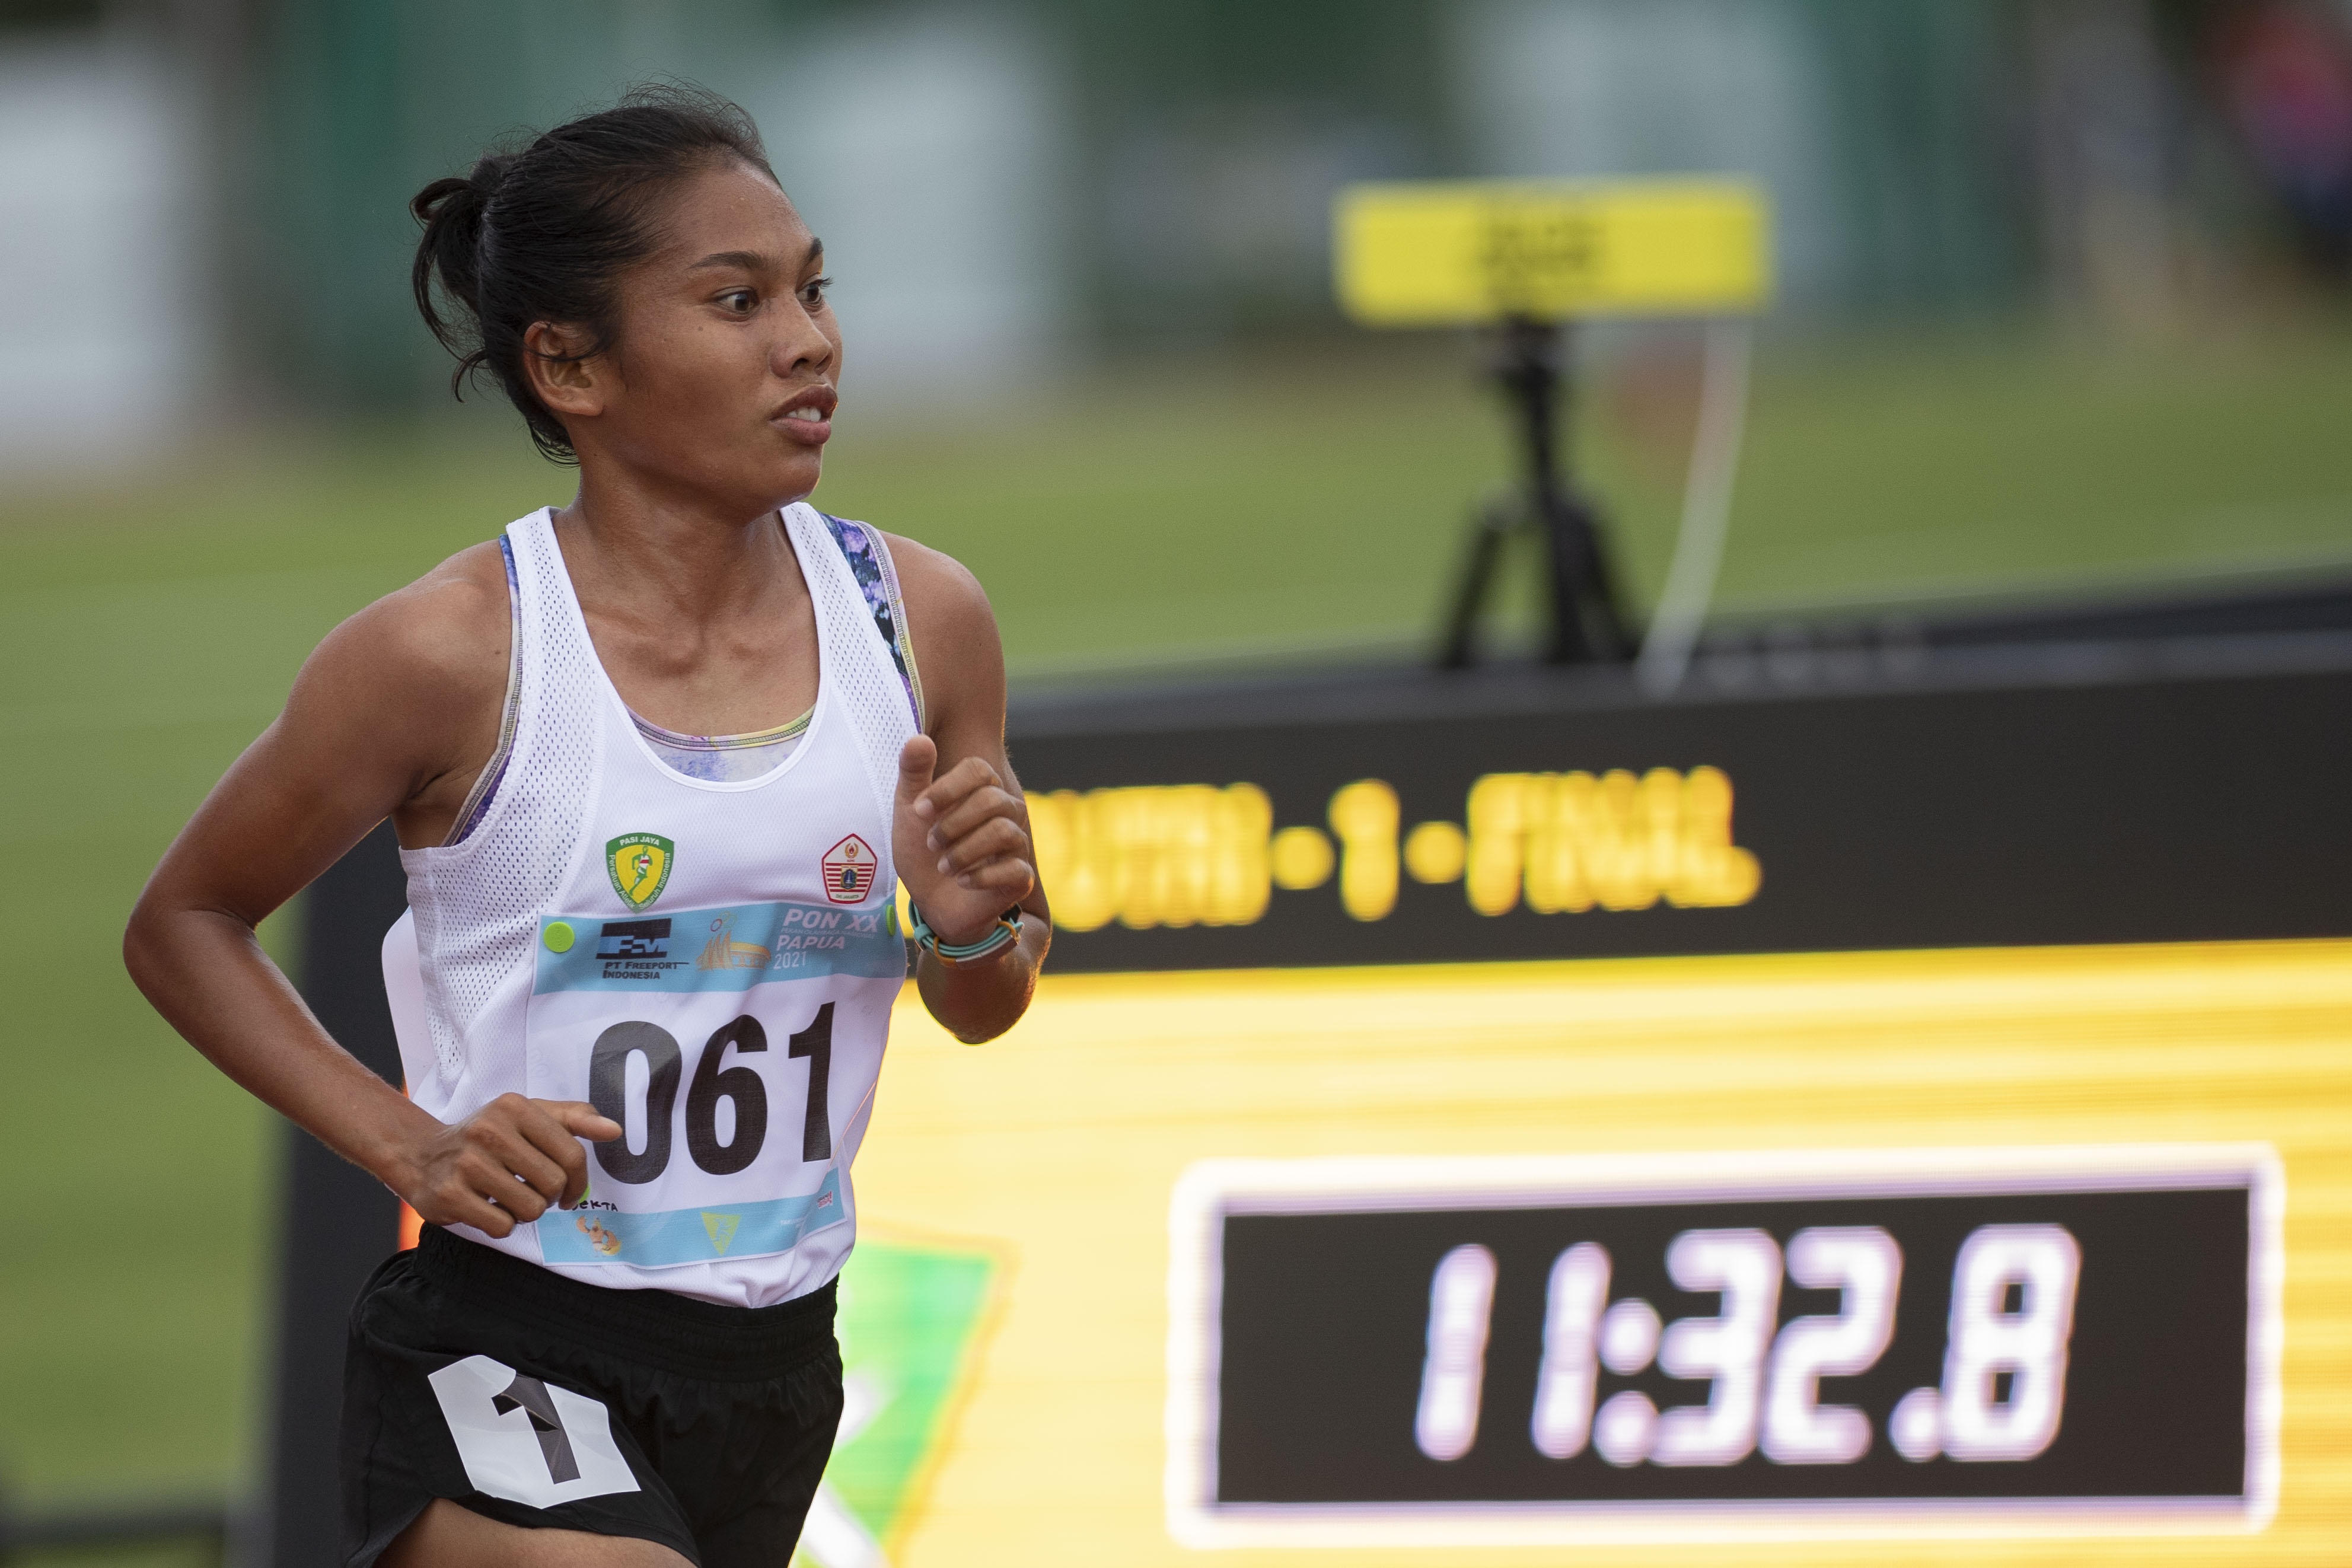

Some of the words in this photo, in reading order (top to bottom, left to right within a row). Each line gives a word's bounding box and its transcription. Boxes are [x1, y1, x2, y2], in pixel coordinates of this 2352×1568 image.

[619, 836, 639, 846] PASI
[640, 836, 659, 846] JAYA
[783, 909, 843, 929] PON
[844, 913, 881, 933] XX
[777, 935, 845, 951] PAPUA
[773, 951, 807, 970] 2021
[589, 1001, 835, 1184] 061
[1413, 1222, 2080, 1467] 11:32.8
[491, 1375, 581, 1484] 1
